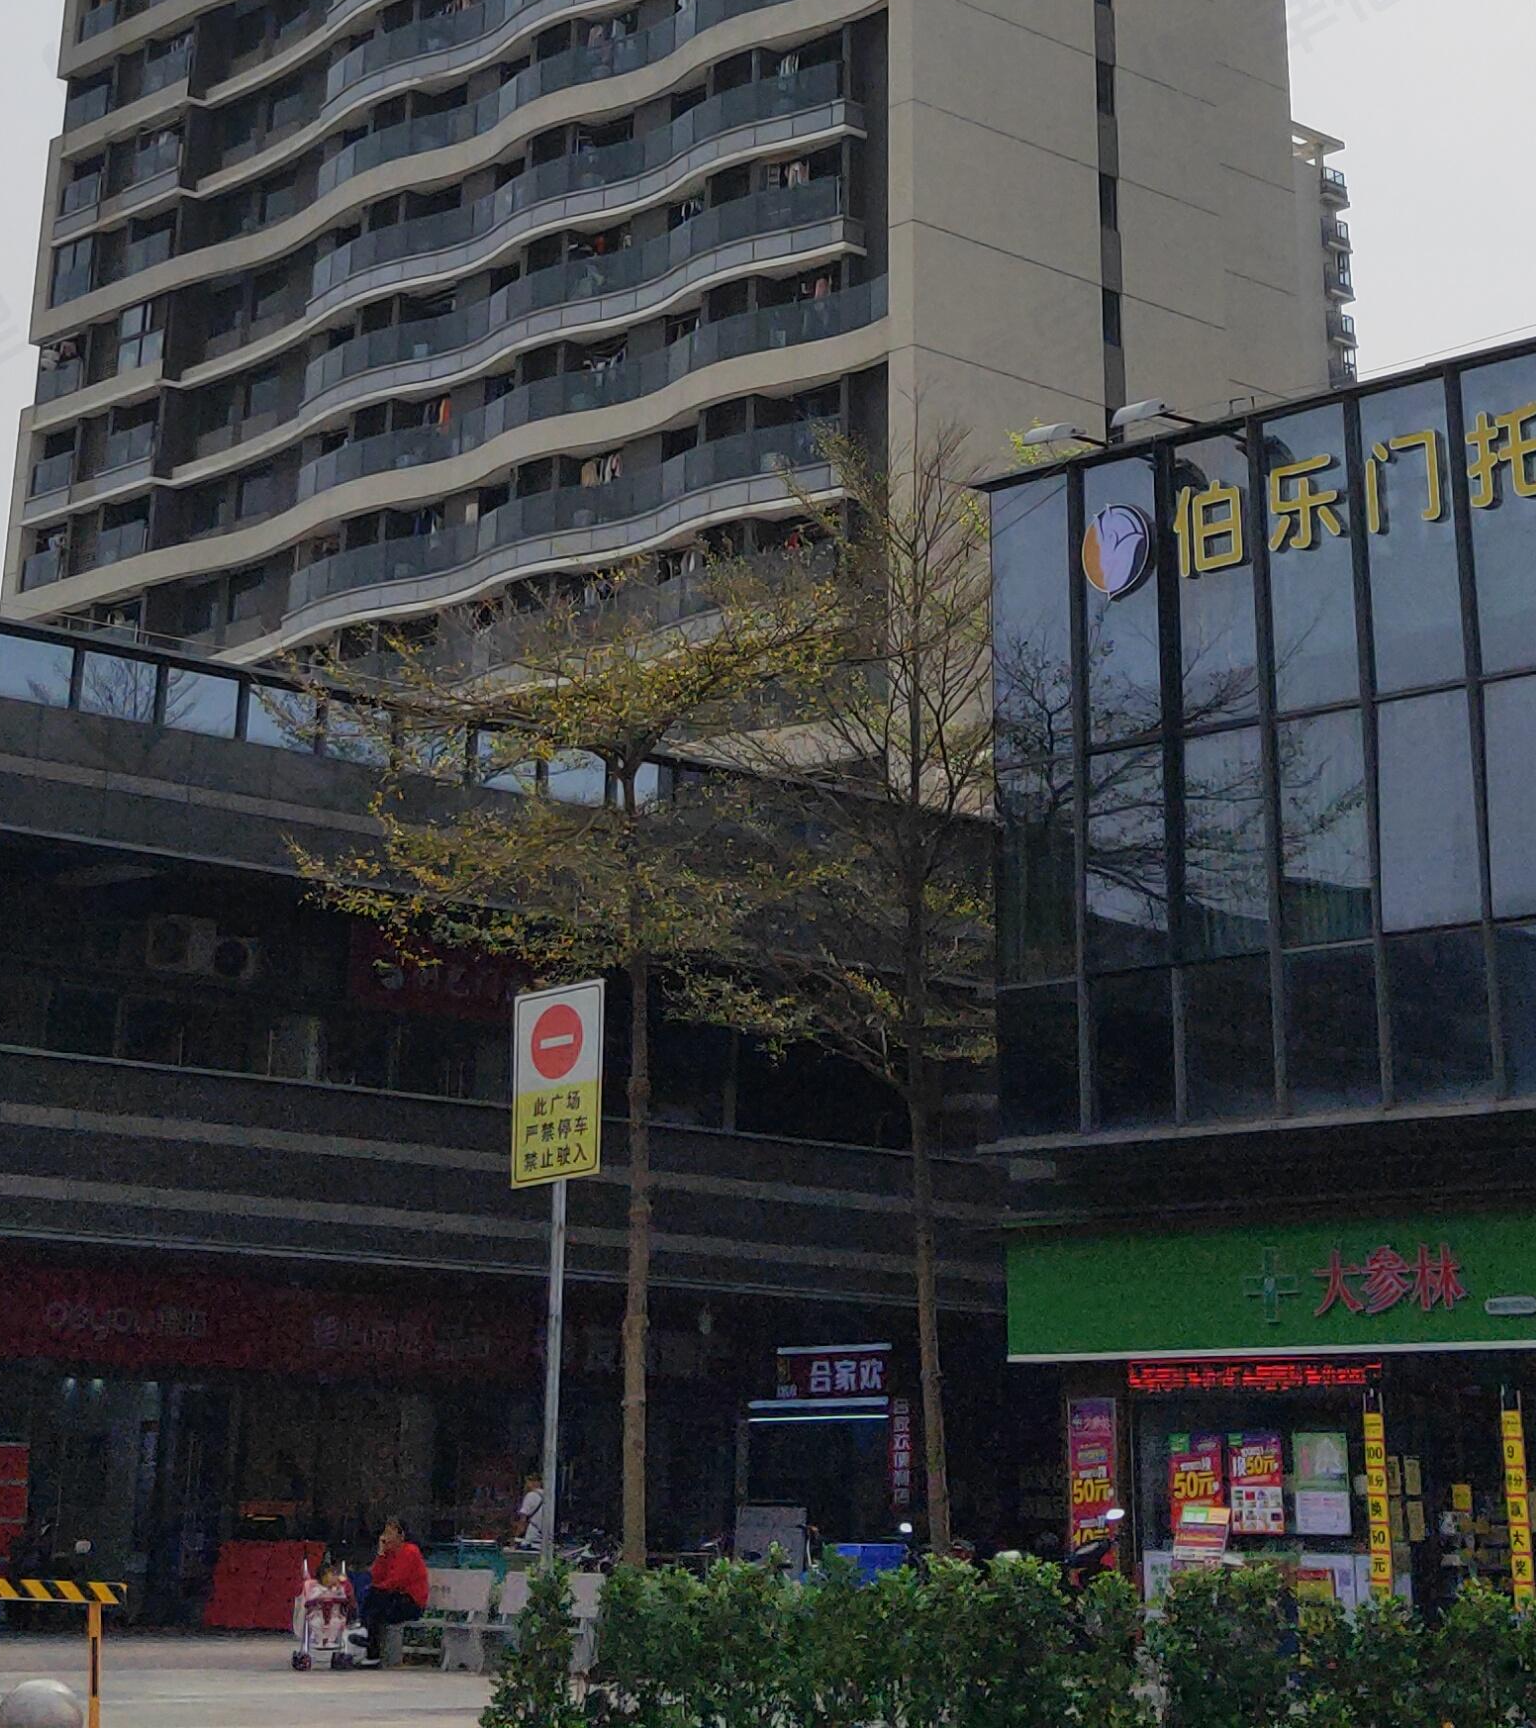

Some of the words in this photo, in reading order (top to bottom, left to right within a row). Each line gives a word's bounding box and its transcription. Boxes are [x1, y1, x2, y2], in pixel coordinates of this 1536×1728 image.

[533, 1090, 581, 1117] 此广场
[525, 1116, 588, 1144] 严禁停车
[524, 1142, 587, 1172] 禁止驶入
[1313, 1242, 1467, 1318] 大参林
